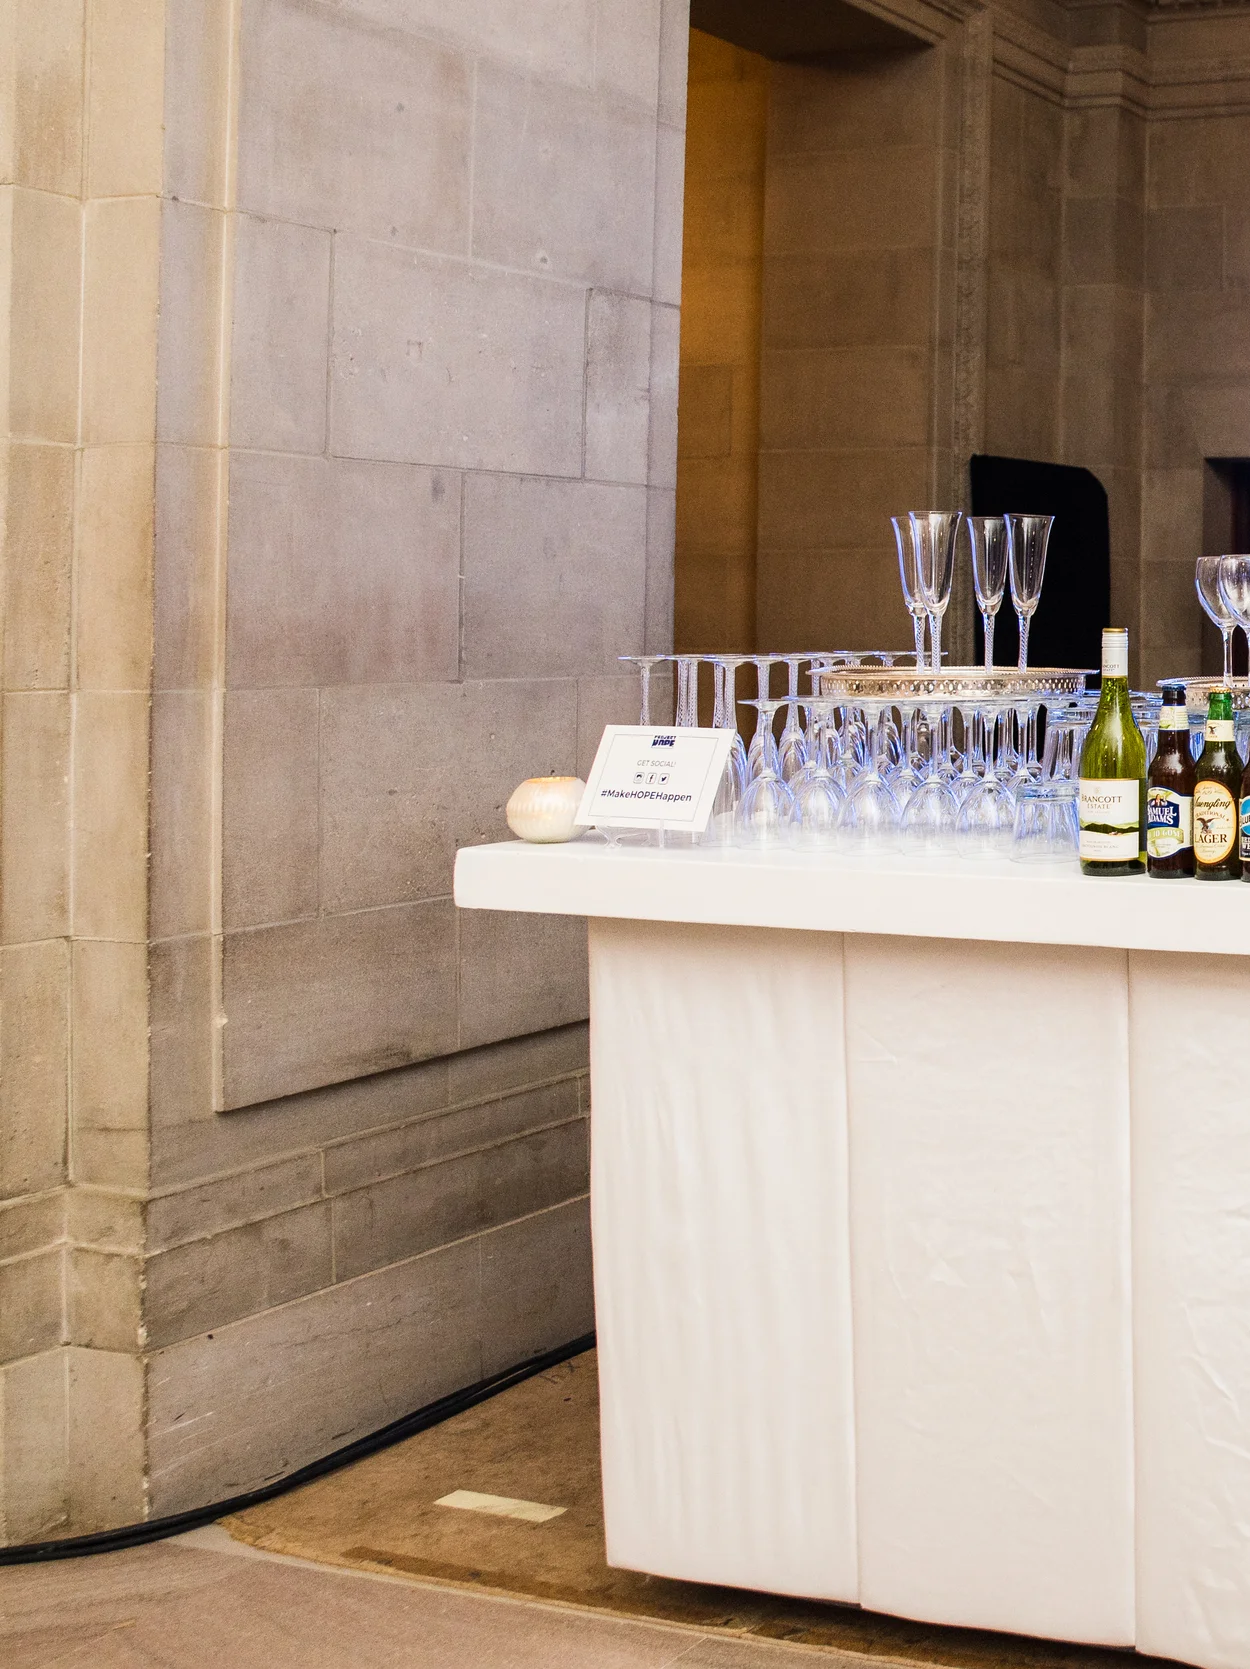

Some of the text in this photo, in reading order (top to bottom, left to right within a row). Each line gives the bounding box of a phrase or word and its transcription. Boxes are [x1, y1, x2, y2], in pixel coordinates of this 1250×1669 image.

[636, 759, 677, 768] GET SOCIAL!
[601, 789, 692, 802] #MakeHOPEHappen
[1081, 794, 1122, 803] BRANCOTT
[1195, 833, 1227, 844] LAGER
